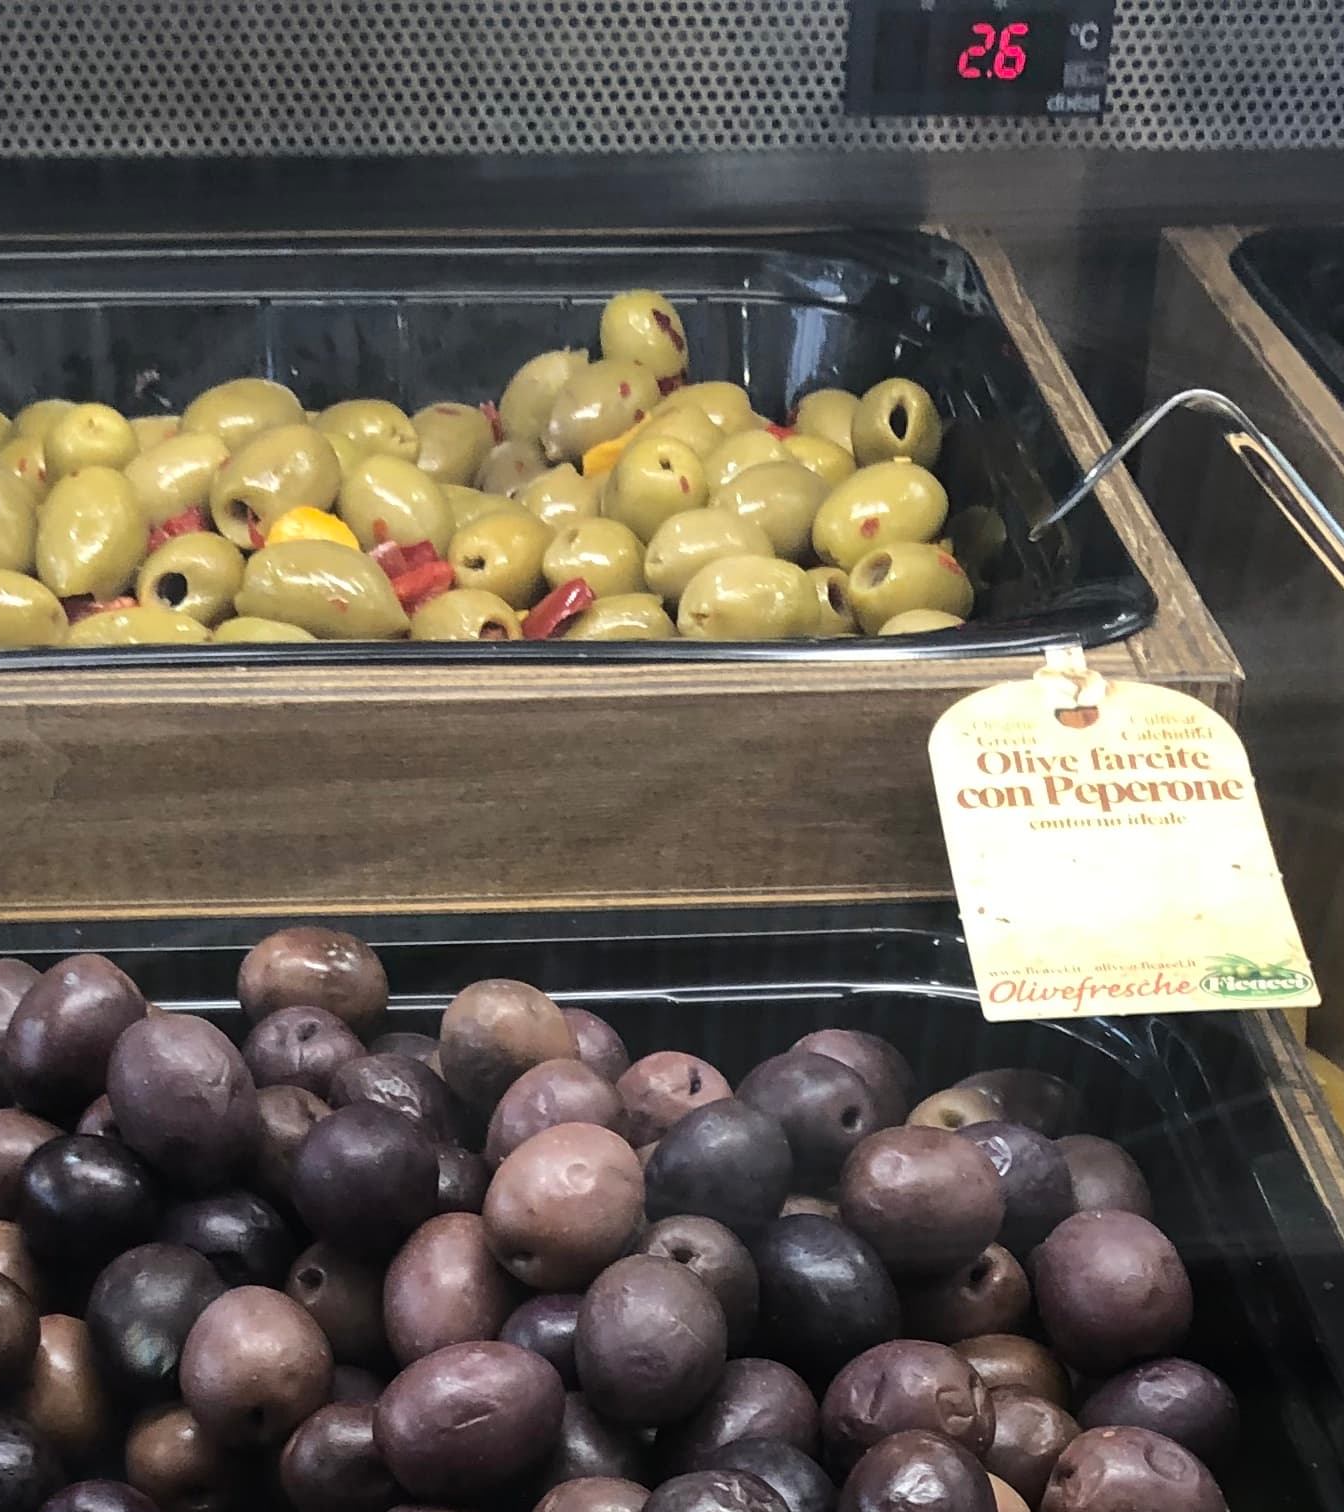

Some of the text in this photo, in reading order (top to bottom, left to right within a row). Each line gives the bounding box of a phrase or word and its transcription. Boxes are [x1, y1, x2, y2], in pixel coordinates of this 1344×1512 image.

[976, 746, 1211, 775] Olive farcite
[956, 775, 1246, 813] con Peperone
[1028, 811, 1189, 831] contorno ideale
[988, 972, 1198, 1013] Olivefresche
